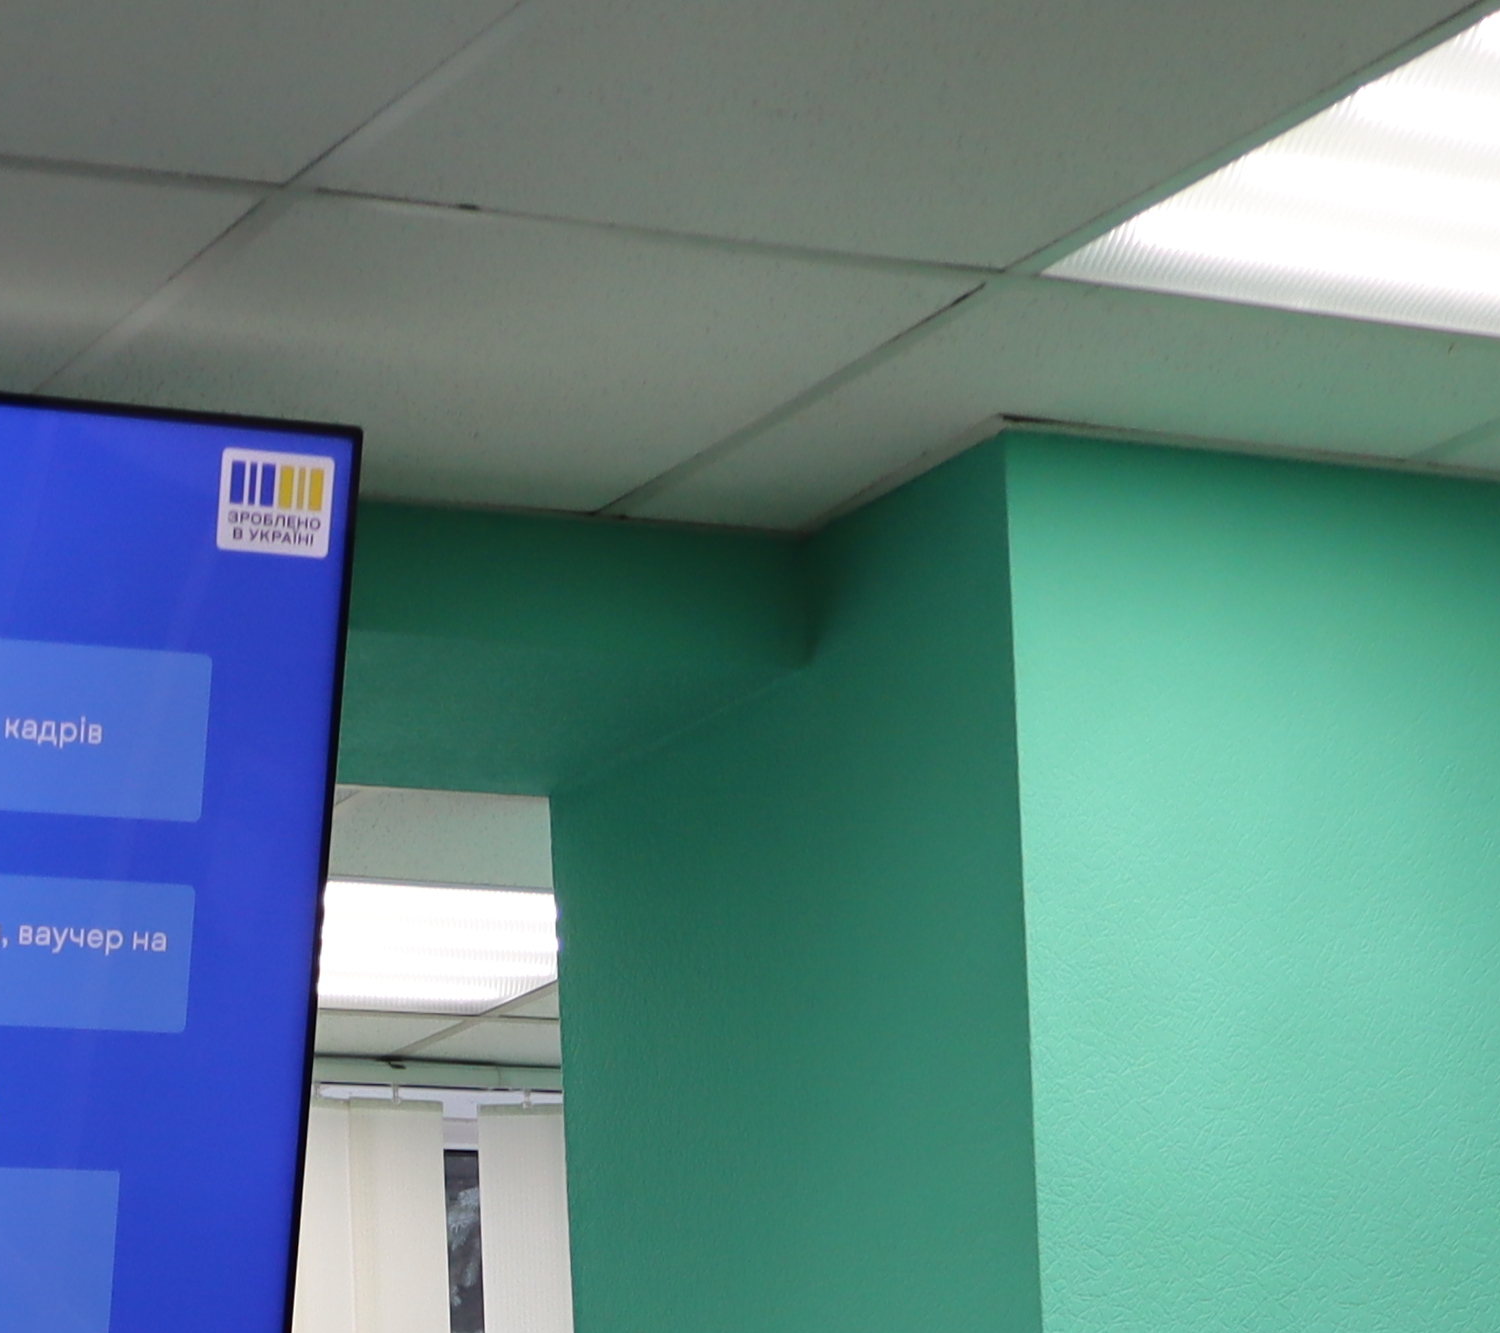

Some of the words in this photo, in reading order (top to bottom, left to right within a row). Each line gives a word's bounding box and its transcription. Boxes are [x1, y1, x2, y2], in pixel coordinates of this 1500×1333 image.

[228, 511, 321, 530] ЗРОБЛЕНО
[233, 528, 243, 539] В
[250, 529, 313, 546] УКРАЇНІ
[5, 716, 102, 748] кадрів
[19, 925, 123, 955] ваучер
[133, 931, 166, 951] на
